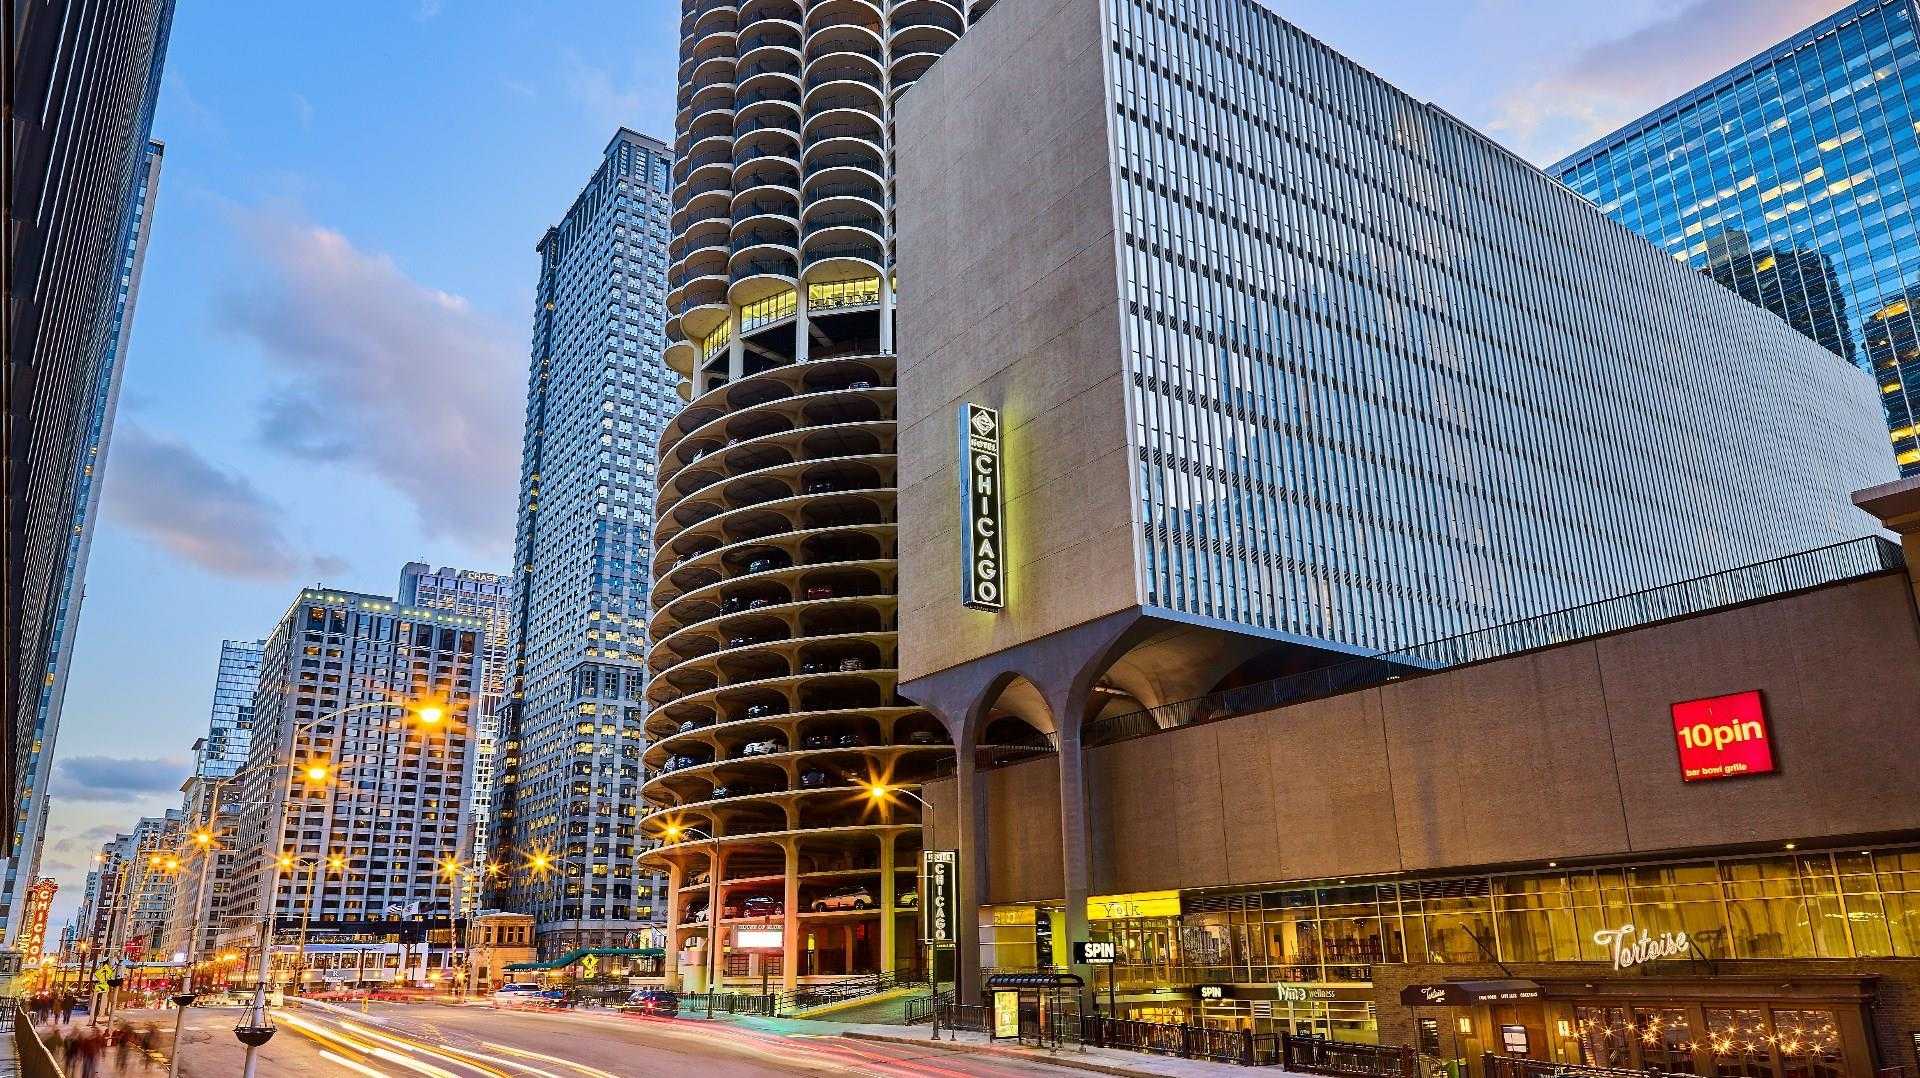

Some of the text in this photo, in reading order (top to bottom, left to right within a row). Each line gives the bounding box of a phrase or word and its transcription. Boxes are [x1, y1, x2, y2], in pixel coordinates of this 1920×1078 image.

[971, 439, 996, 451] HOTEL
[976, 454, 997, 602] CHICAGO
[468, 572, 498, 583] CHASE
[1679, 718, 1763, 751] 10pin
[1686, 768, 1700, 777] bar
[1702, 766, 1723, 775] bowl
[935, 863, 946, 941] CHICAGO
[28, 890, 49, 964] CHICAGO
[1084, 942, 1115, 958] SPIN
[1593, 924, 1690, 972] Tortoise
[1201, 986, 1222, 998] SPIN
[1308, 988, 1336, 998] wellness
